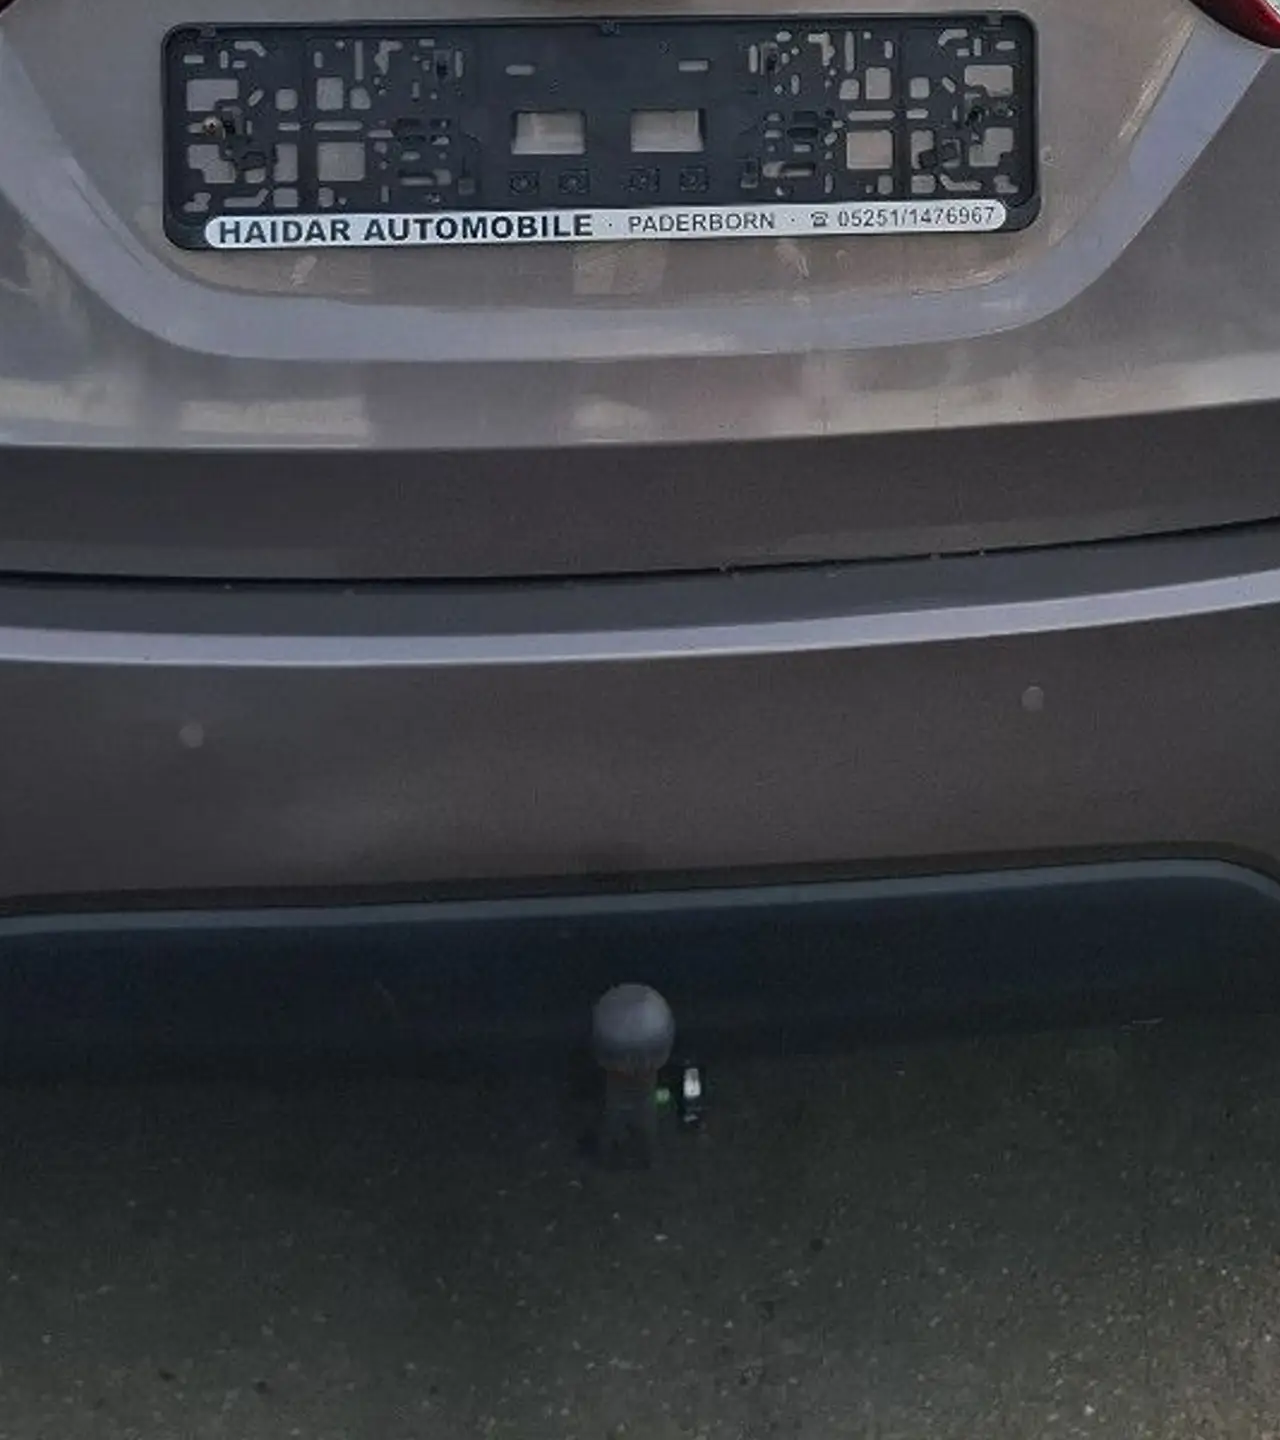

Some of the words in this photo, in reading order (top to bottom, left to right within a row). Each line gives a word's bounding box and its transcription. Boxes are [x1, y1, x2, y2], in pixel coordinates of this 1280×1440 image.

[220, 218, 351, 244] HAIDAR
[364, 214, 593, 242] AUTOMOBILE
[628, 212, 776, 232] PADERBORN
[837, 206, 995, 228] 05251/1476967
